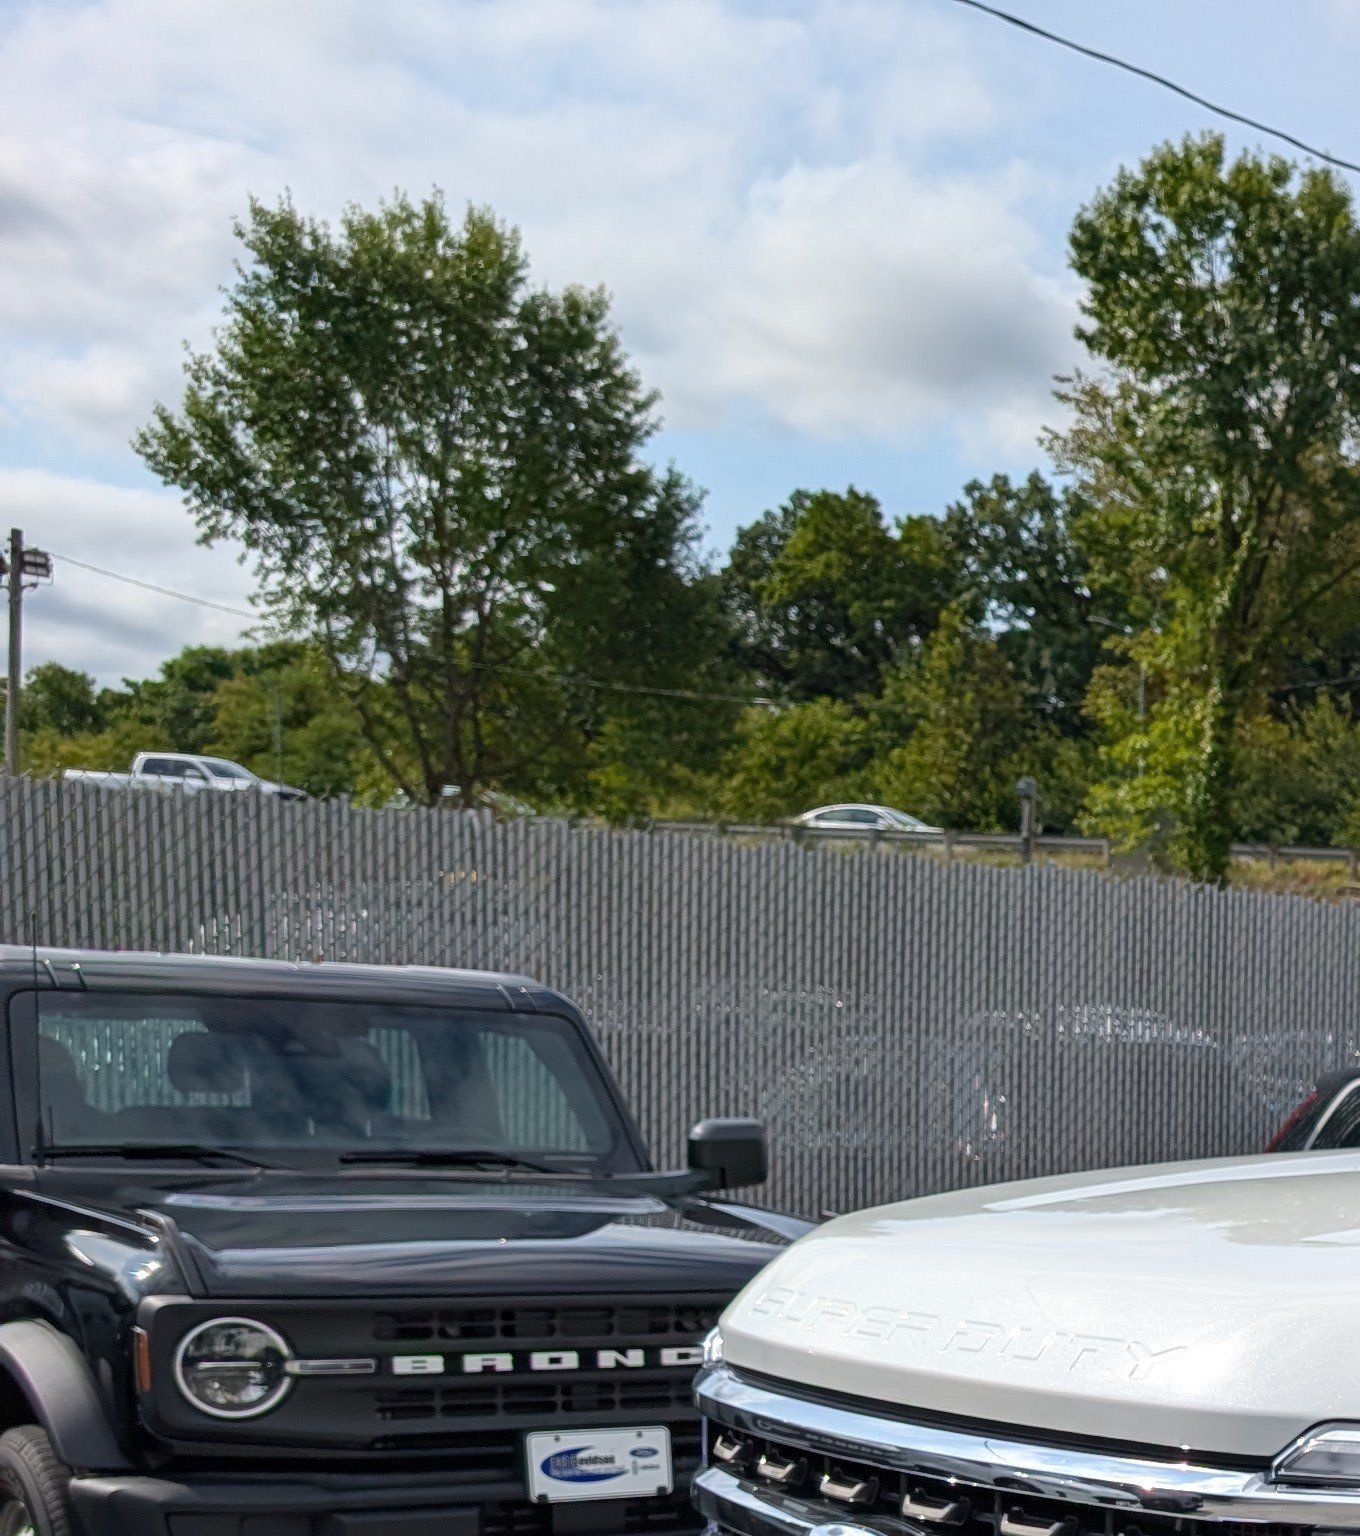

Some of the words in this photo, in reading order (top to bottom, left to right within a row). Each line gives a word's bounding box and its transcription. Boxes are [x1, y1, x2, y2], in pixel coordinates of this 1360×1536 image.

[392, 1348, 704, 1374] BRONC
[752, 1285, 942, 1352] SUPER
[938, 1318, 1189, 1379] DUTY
